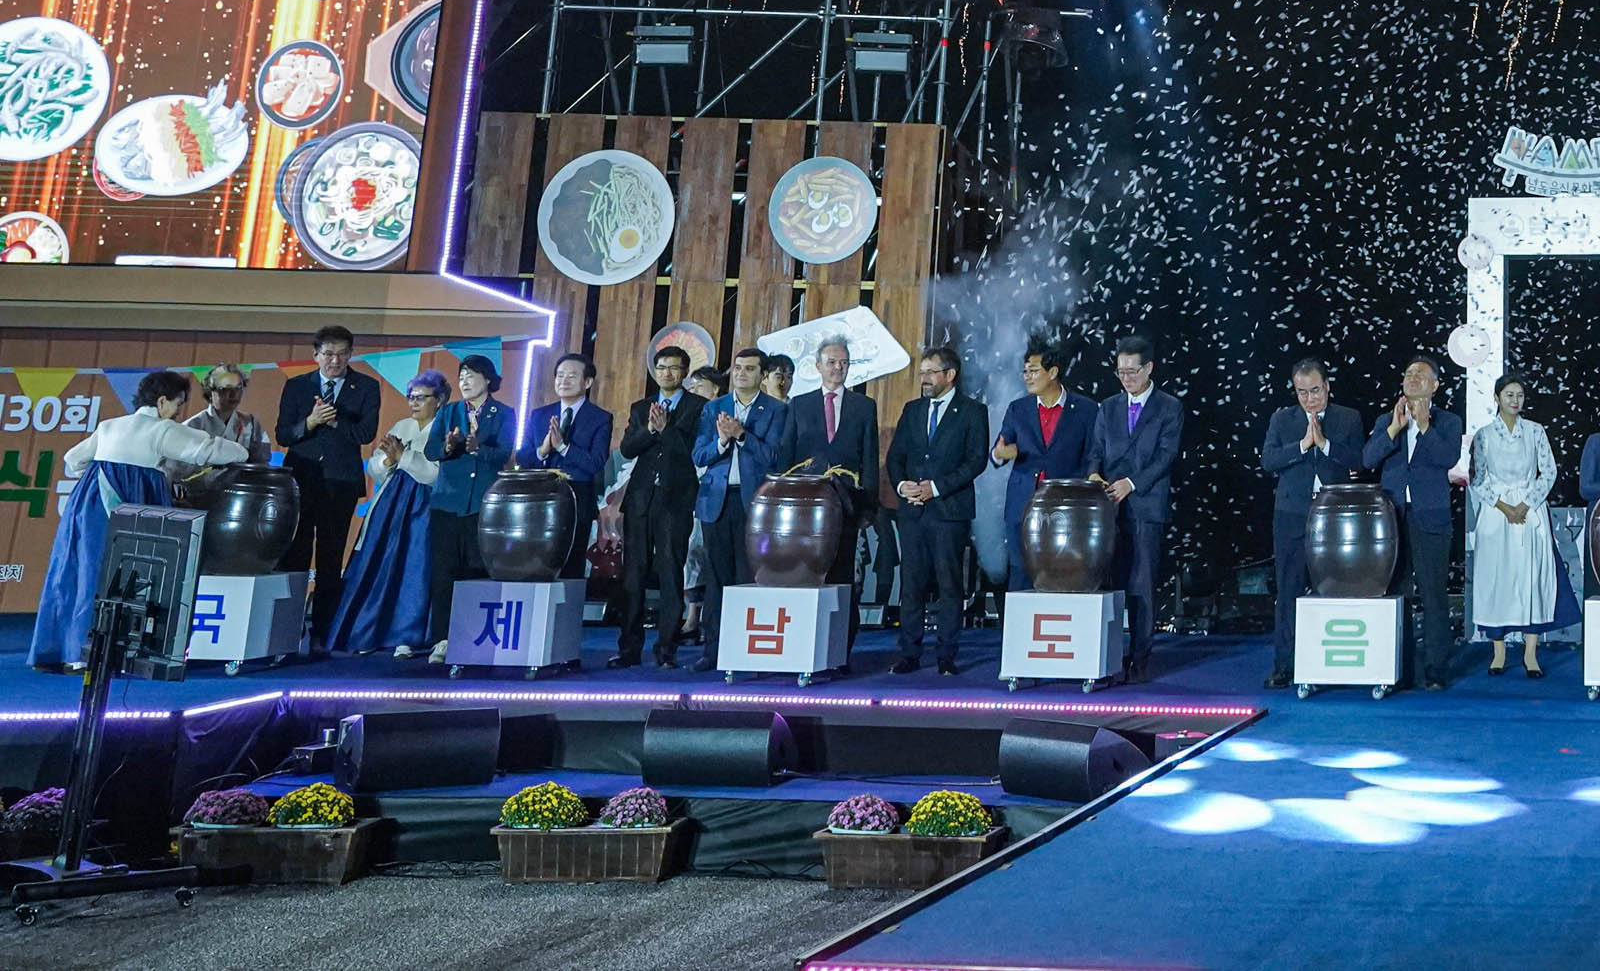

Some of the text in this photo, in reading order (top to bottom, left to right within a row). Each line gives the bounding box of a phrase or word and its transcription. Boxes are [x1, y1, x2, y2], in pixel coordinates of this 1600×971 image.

[0, 394, 101, 432] 30회
[474, 600, 523, 650] 제
[746, 607, 791, 655] 남
[1028, 613, 1074, 660] 도
[1322, 619, 1369, 667] 음
